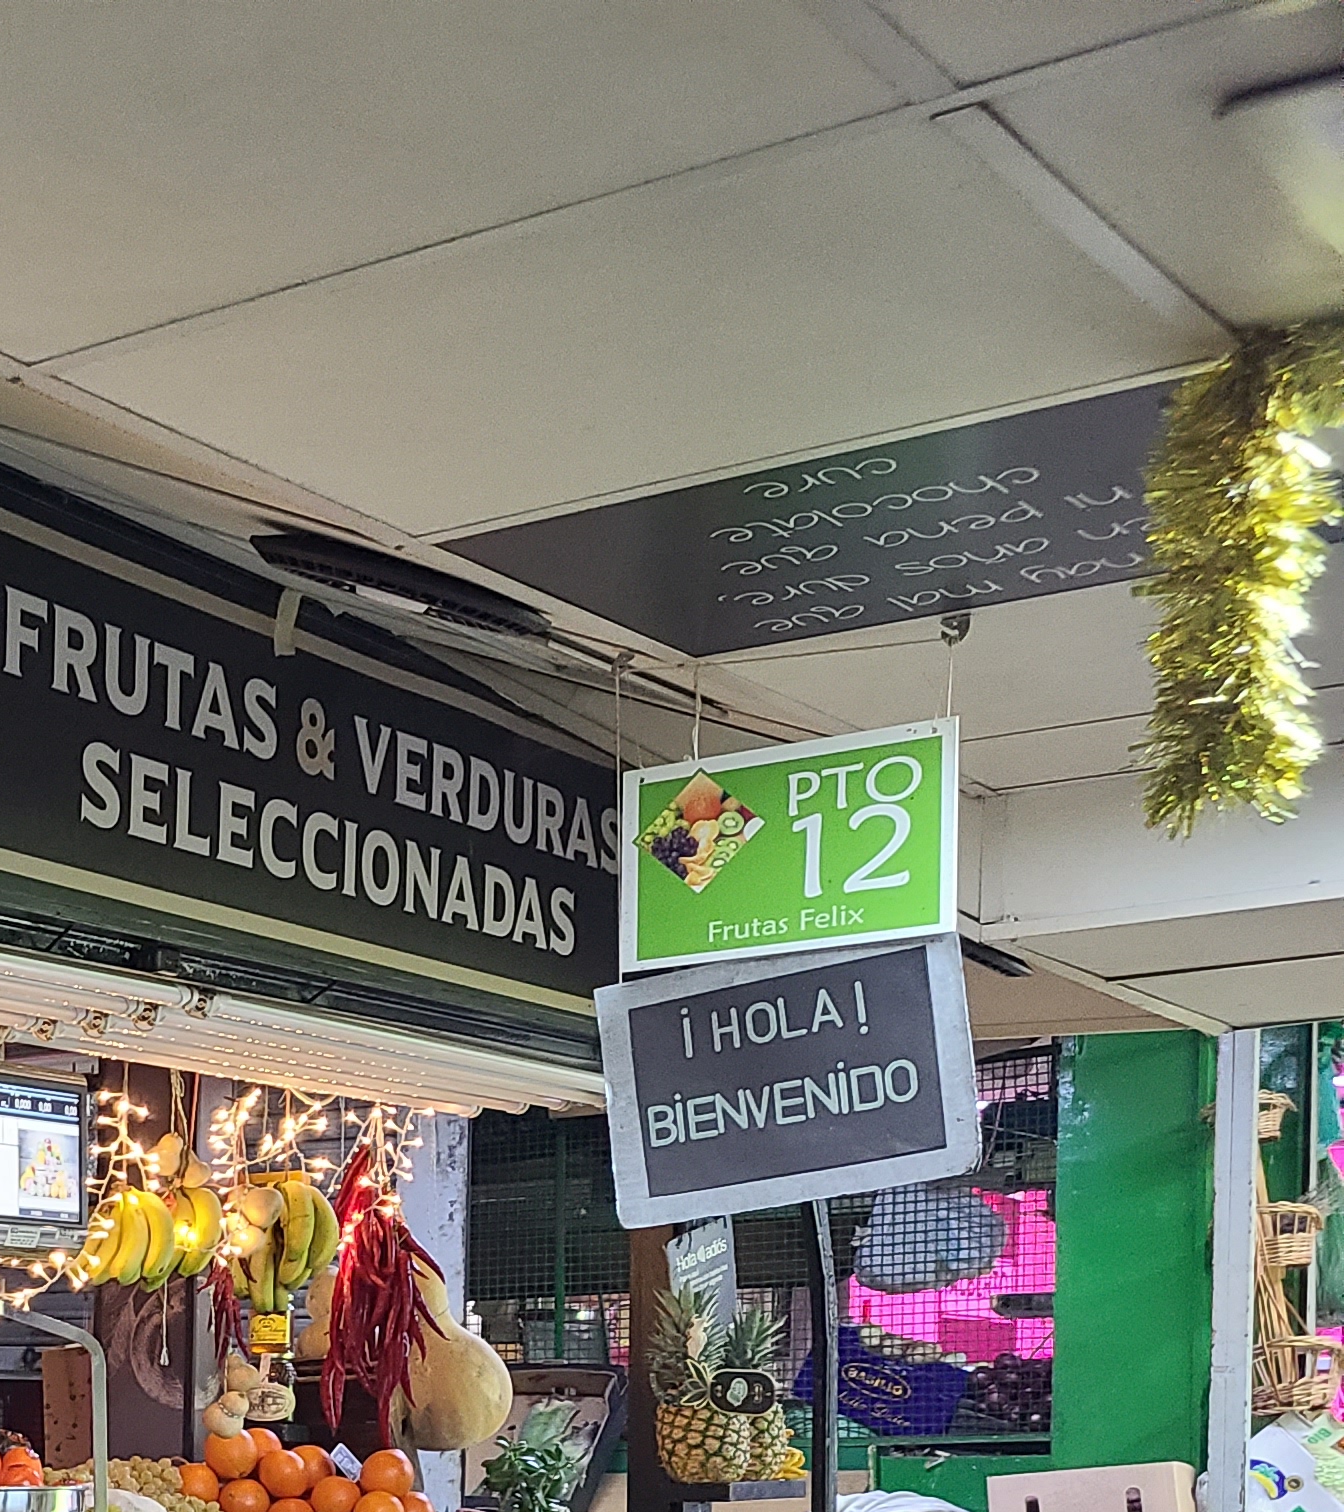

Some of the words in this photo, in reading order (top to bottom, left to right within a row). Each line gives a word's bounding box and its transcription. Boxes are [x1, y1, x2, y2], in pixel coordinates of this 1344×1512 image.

[743, 458, 897, 498] cure
[710, 467, 1040, 542] chocolate
[863, 500, 1044, 548] pena
[721, 544, 838, 575] que
[895, 537, 1050, 576] años
[886, 580, 1004, 611] mal
[753, 604, 864, 631] que
[3, 585, 278, 762] FRUTAS
[295, 698, 335, 781] &
[353, 714, 619, 876] VERDURAS
[788, 755, 923, 817] PTO
[80, 740, 576, 956] SELECCIONADAS
[793, 803, 910, 898] 12
[708, 913, 789, 943] Frutas
[800, 904, 865, 932] Felix
[676, 1252, 697, 1273] Hola
[1308, 1427, 1333, 1445] Bio
